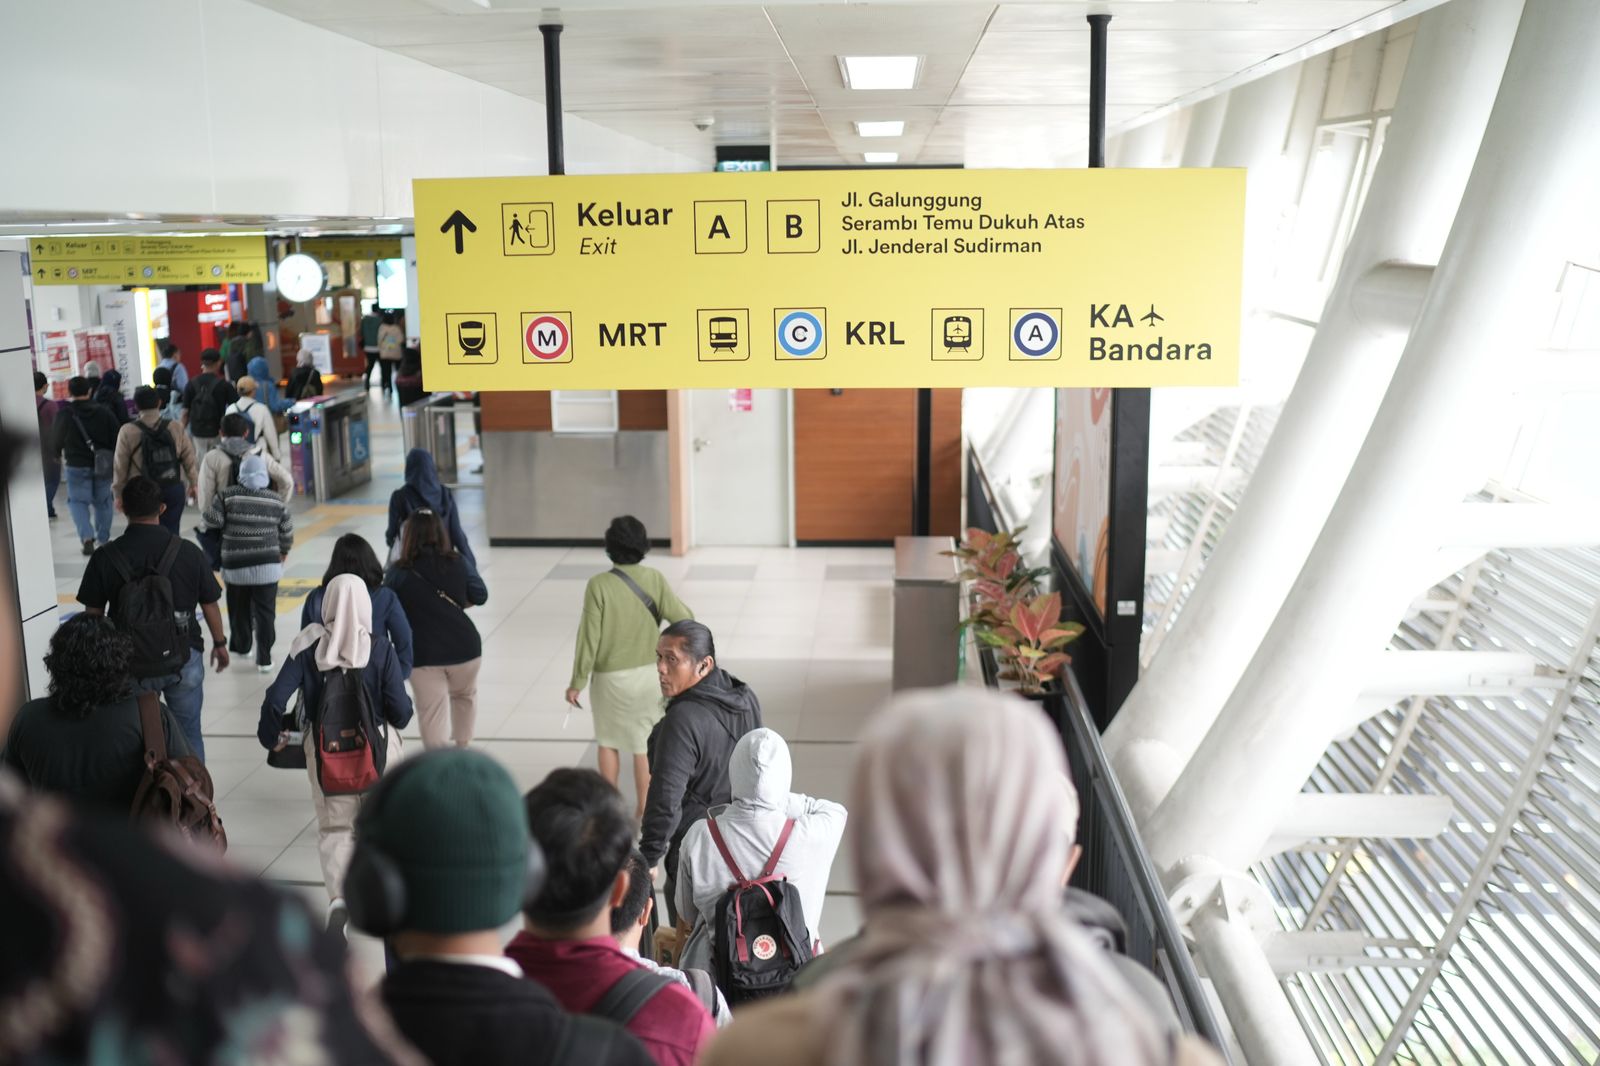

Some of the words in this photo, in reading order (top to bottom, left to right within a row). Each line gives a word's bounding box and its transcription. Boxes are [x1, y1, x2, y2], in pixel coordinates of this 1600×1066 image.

[723, 160, 764, 172] EXIT
[841, 191, 863, 208] Jl.
[868, 191, 982, 212] Galunggung
[577, 201, 674, 227] Keluar
[922, 214, 973, 231] Temu
[979, 213, 1039, 230] Dukuh
[1044, 213, 1085, 229] Atas
[708, 214, 731, 239] A
[785, 214, 803, 239] B
[579, 236, 618, 255] Exit
[841, 238, 863, 255] Jl.
[868, 237, 948, 255] Jenderal
[953, 236, 1042, 254] Sudirman
[1089, 303, 1134, 329] KA
[537, 329, 557, 348] M
[599, 322, 668, 347] MRT
[791, 325, 809, 343] C
[846, 321, 905, 346] KRL
[1028, 325, 1044, 342] A
[1089, 336, 1213, 361] Bandara
